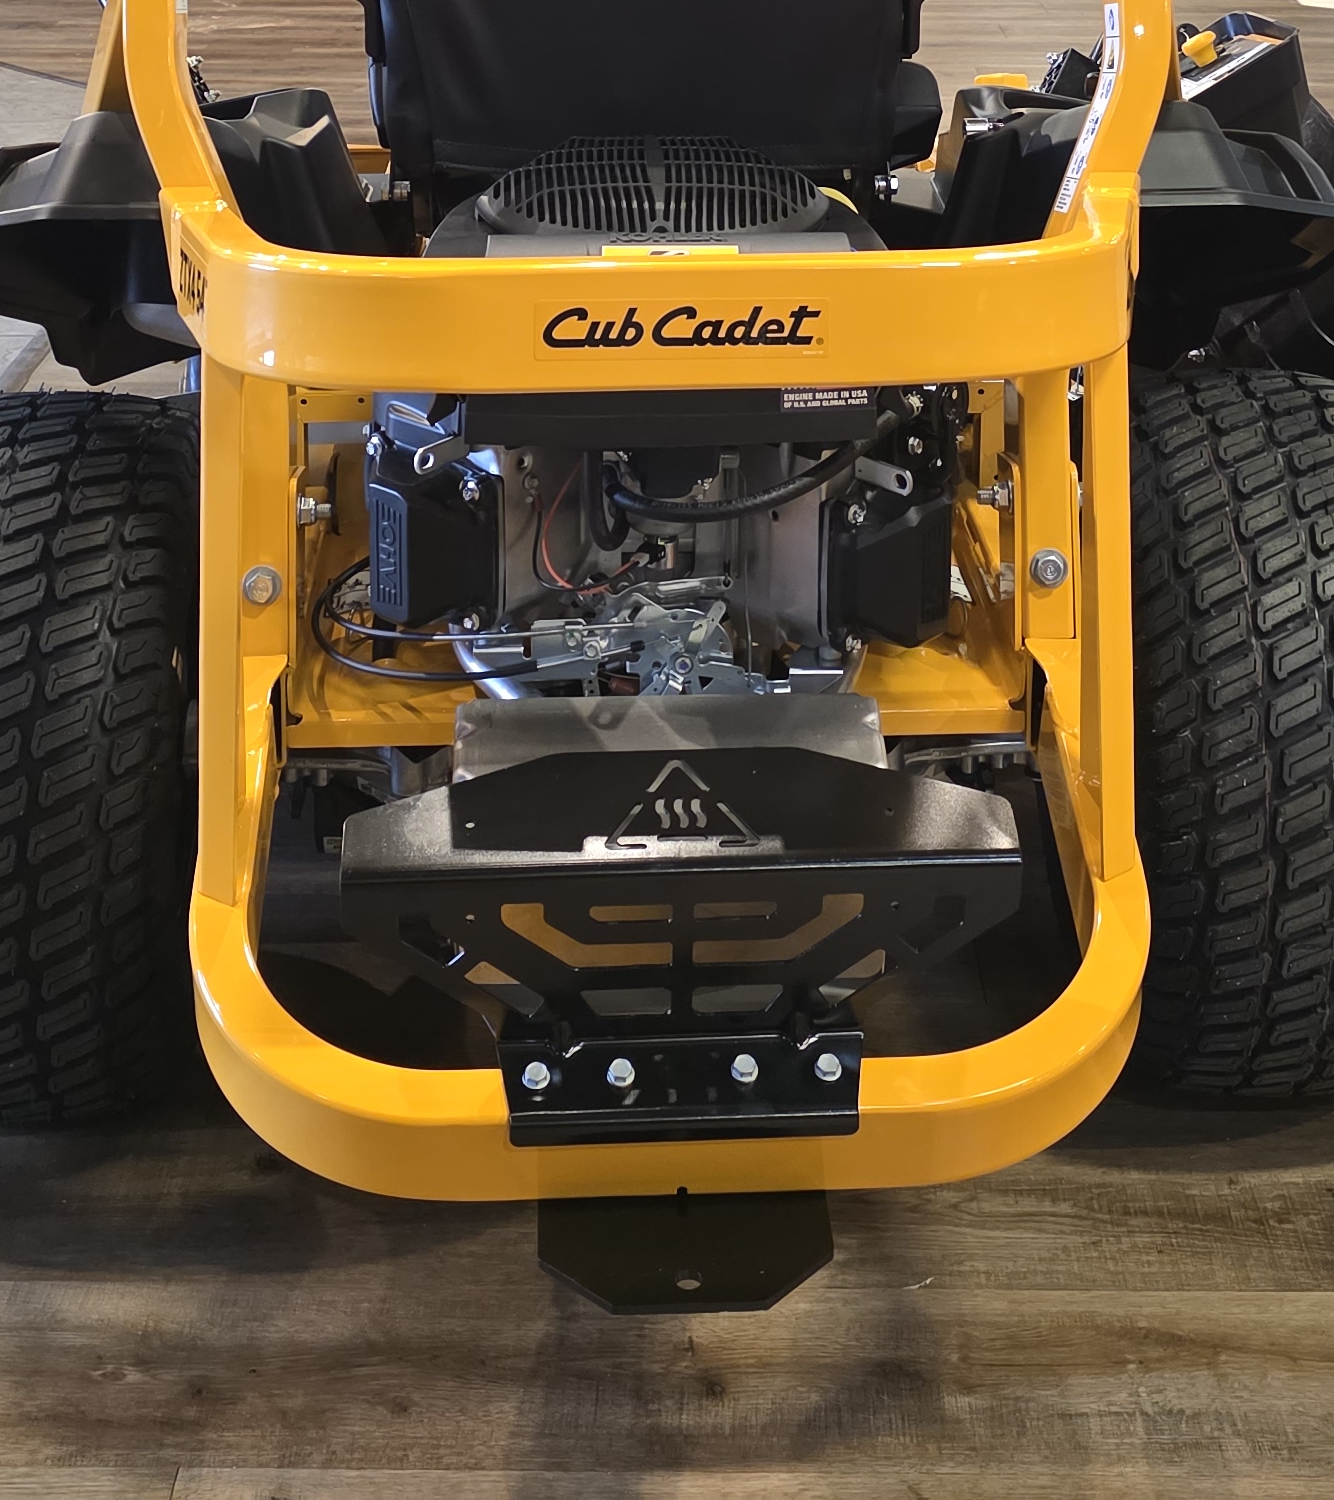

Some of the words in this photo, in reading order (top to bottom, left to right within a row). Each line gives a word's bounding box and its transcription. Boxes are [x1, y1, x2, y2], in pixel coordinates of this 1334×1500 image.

[542, 306, 645, 349] Cub
[651, 305, 822, 347] Cadet
[783, 392, 814, 401] ENGINE
[814, 391, 839, 400] MADE
[840, 390, 850, 399] IN
[851, 389, 869, 398] USA
[783, 401, 792, 409] OF
[807, 400, 821, 408] AND
[821, 399, 846, 407] GLOBAL
